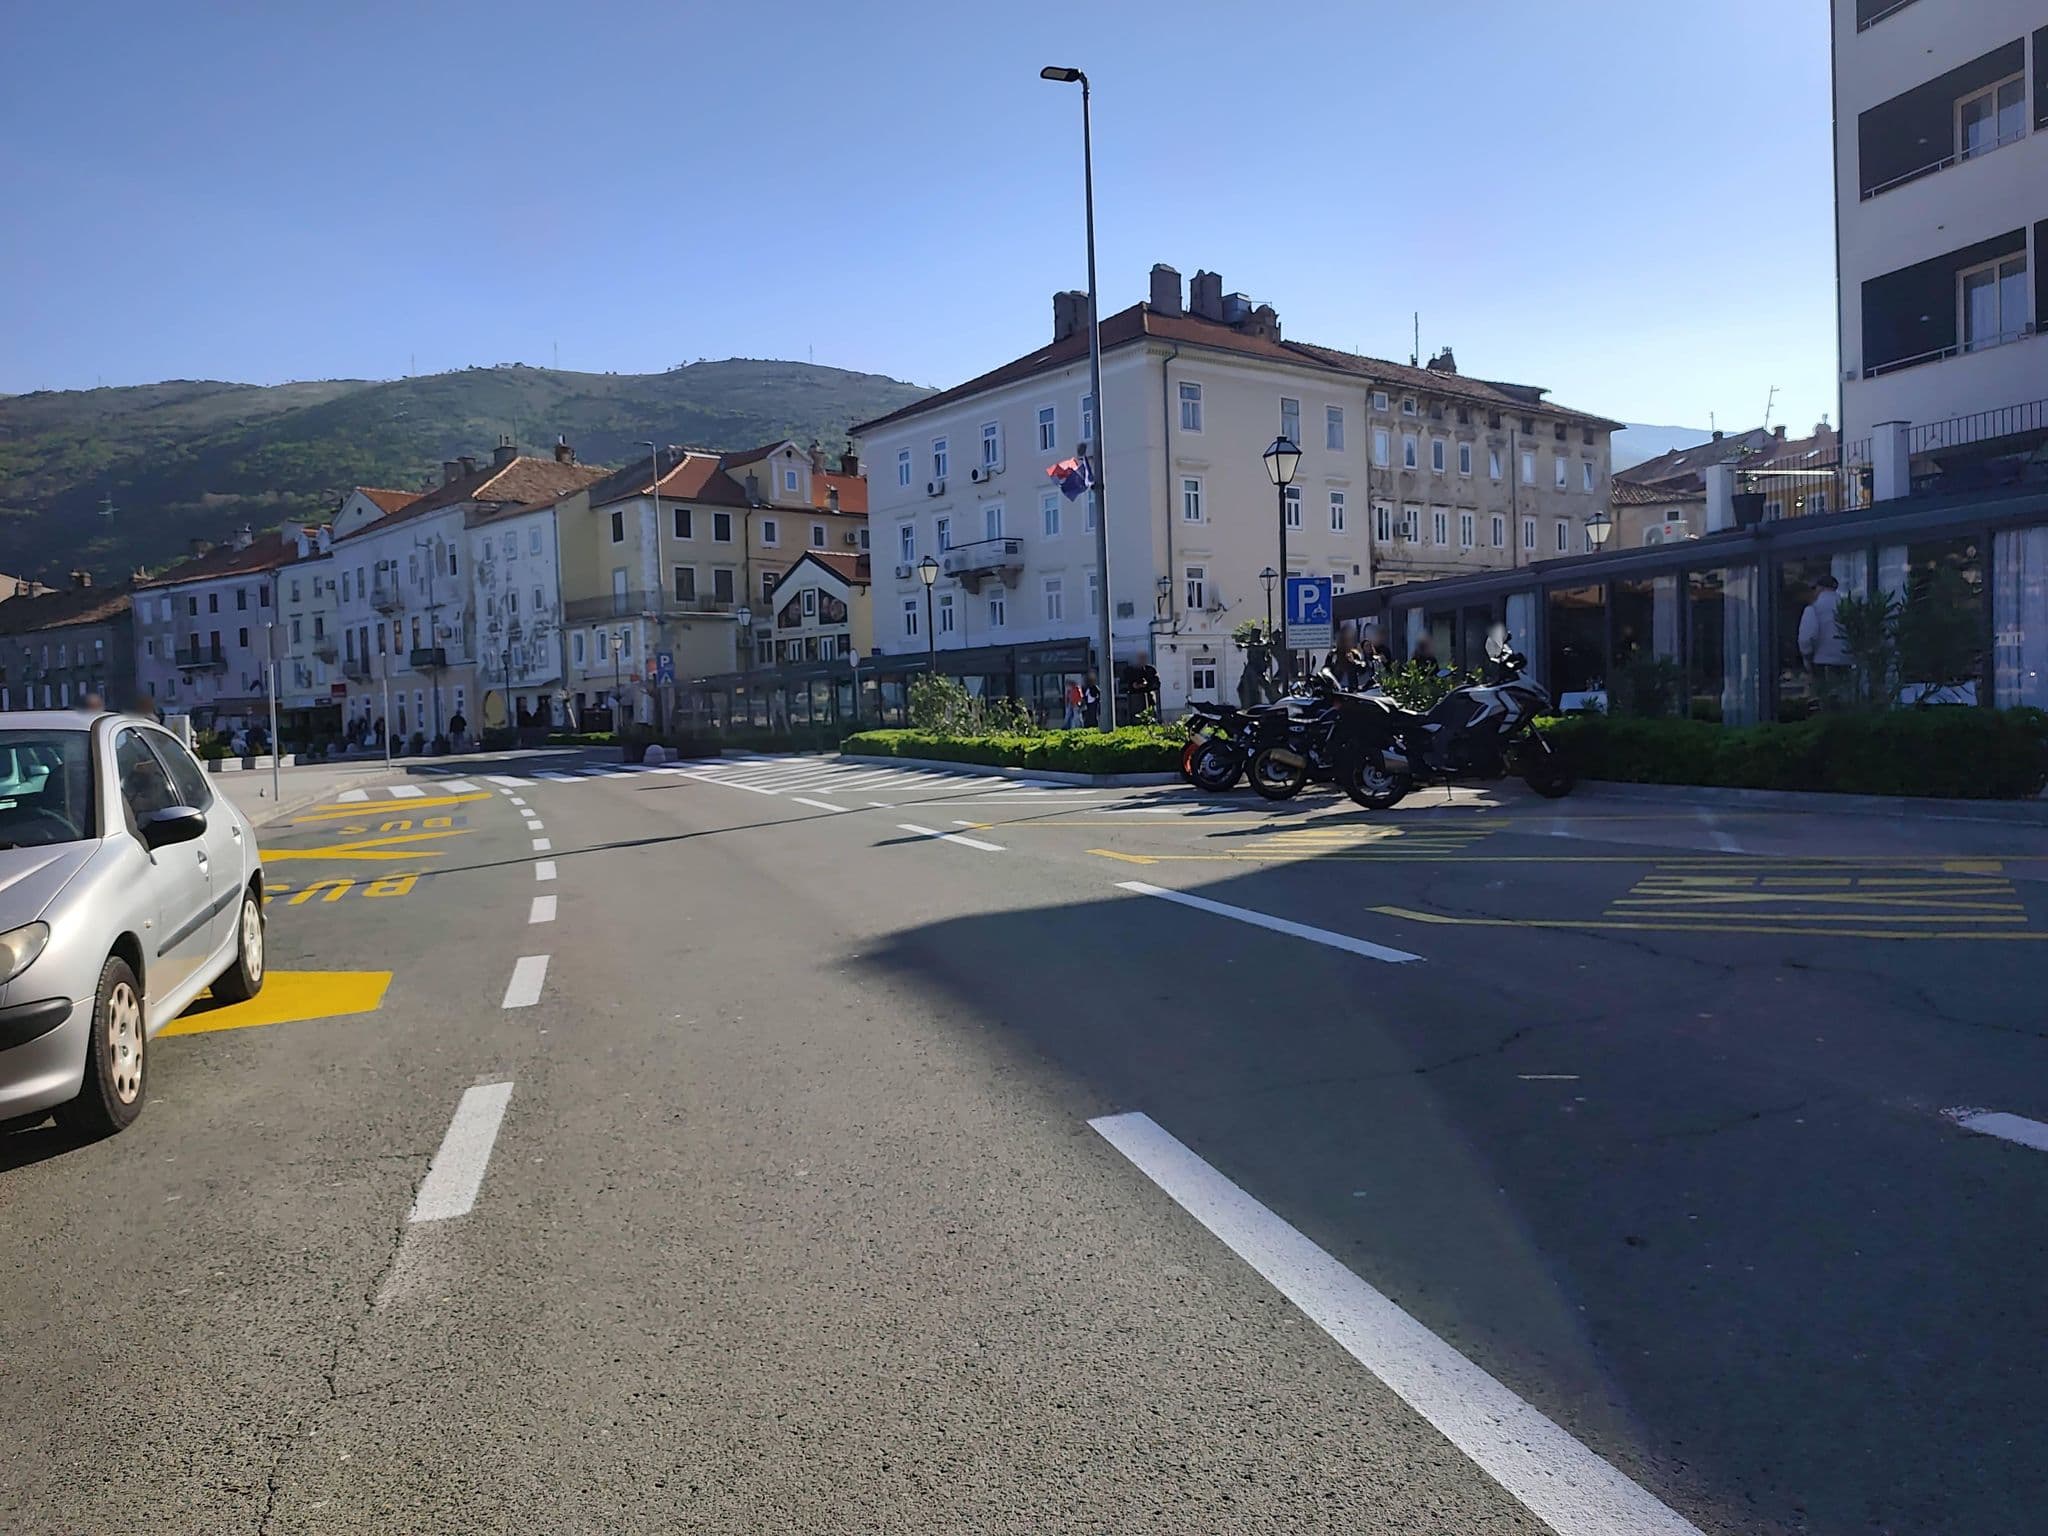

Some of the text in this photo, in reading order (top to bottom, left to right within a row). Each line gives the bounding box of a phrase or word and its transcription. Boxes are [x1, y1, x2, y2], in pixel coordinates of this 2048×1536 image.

[1299, 584, 1319, 623] P
[660, 655, 670, 667] P
[338, 817, 452, 834] BUS
[1602, 860, 2029, 922] TAXI
